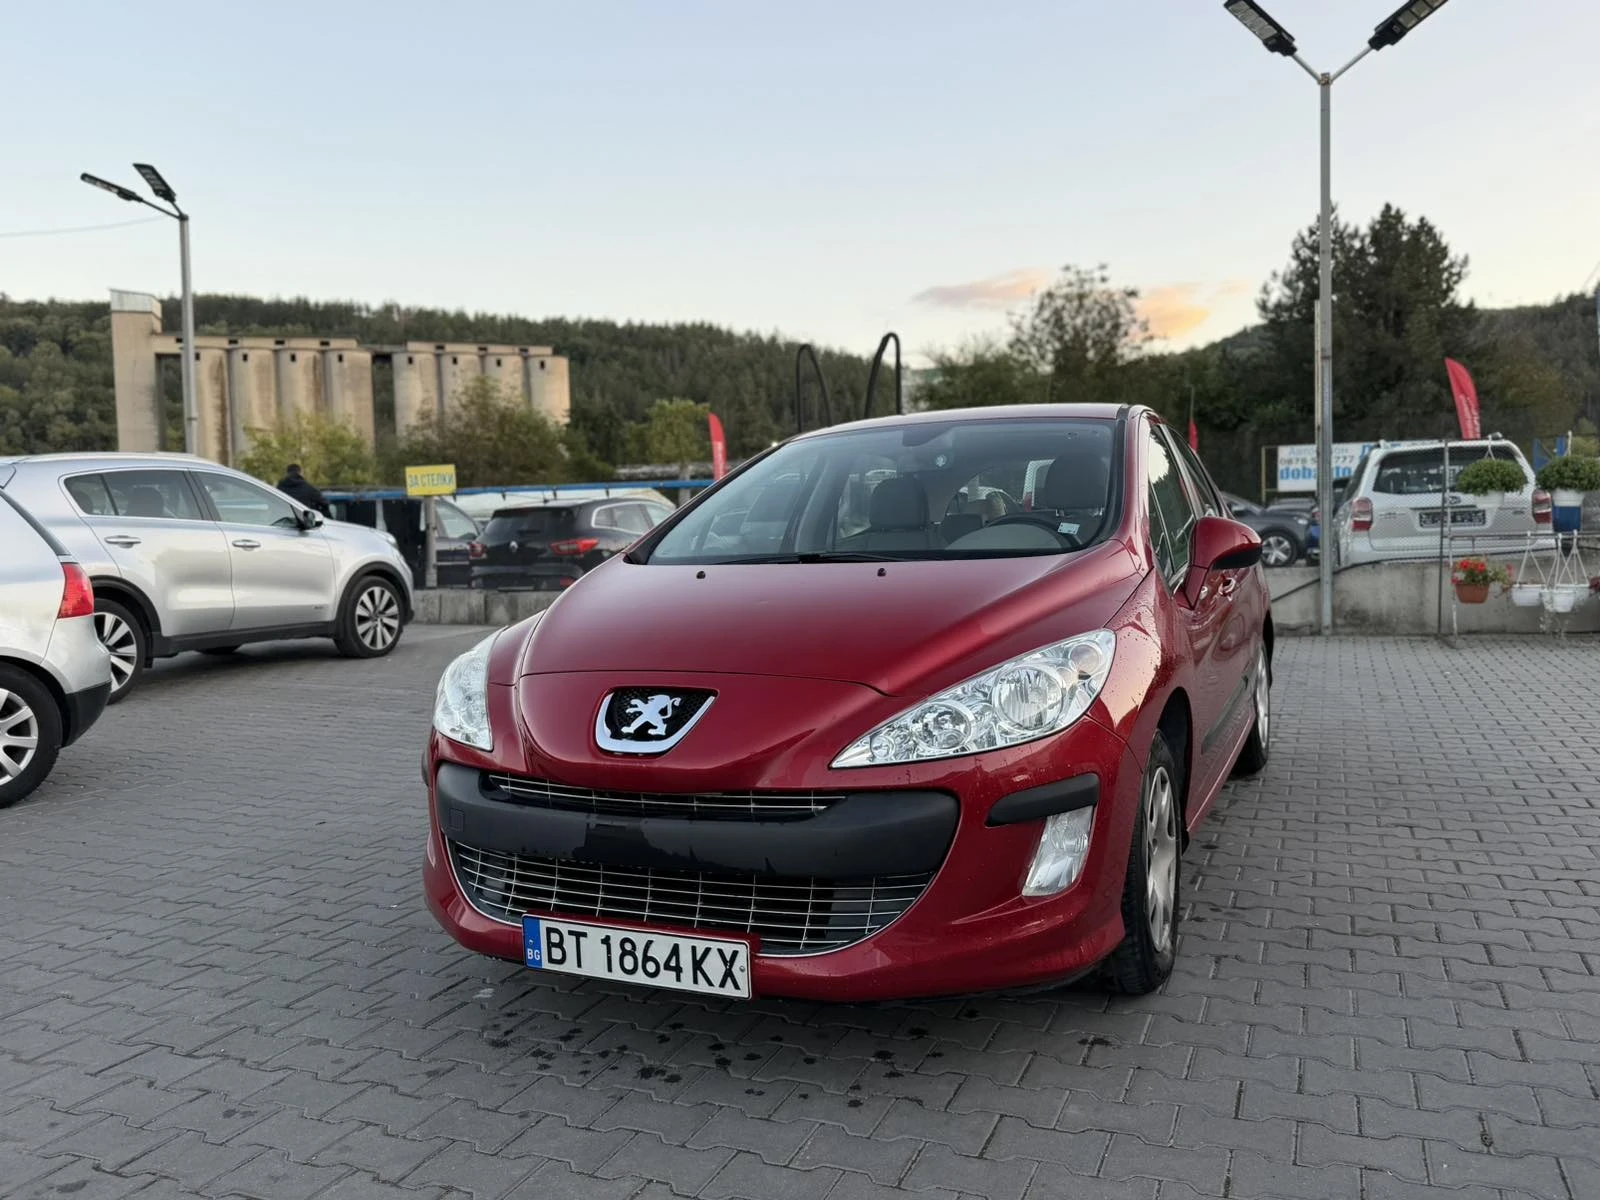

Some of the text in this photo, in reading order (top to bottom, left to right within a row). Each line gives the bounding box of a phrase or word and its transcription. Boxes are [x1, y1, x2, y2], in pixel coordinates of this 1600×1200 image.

[1279, 466, 1352, 480] dobto
[408, 474, 420, 488] ЗА
[545, 926, 588, 968] BT
[527, 948, 541, 961] BG
